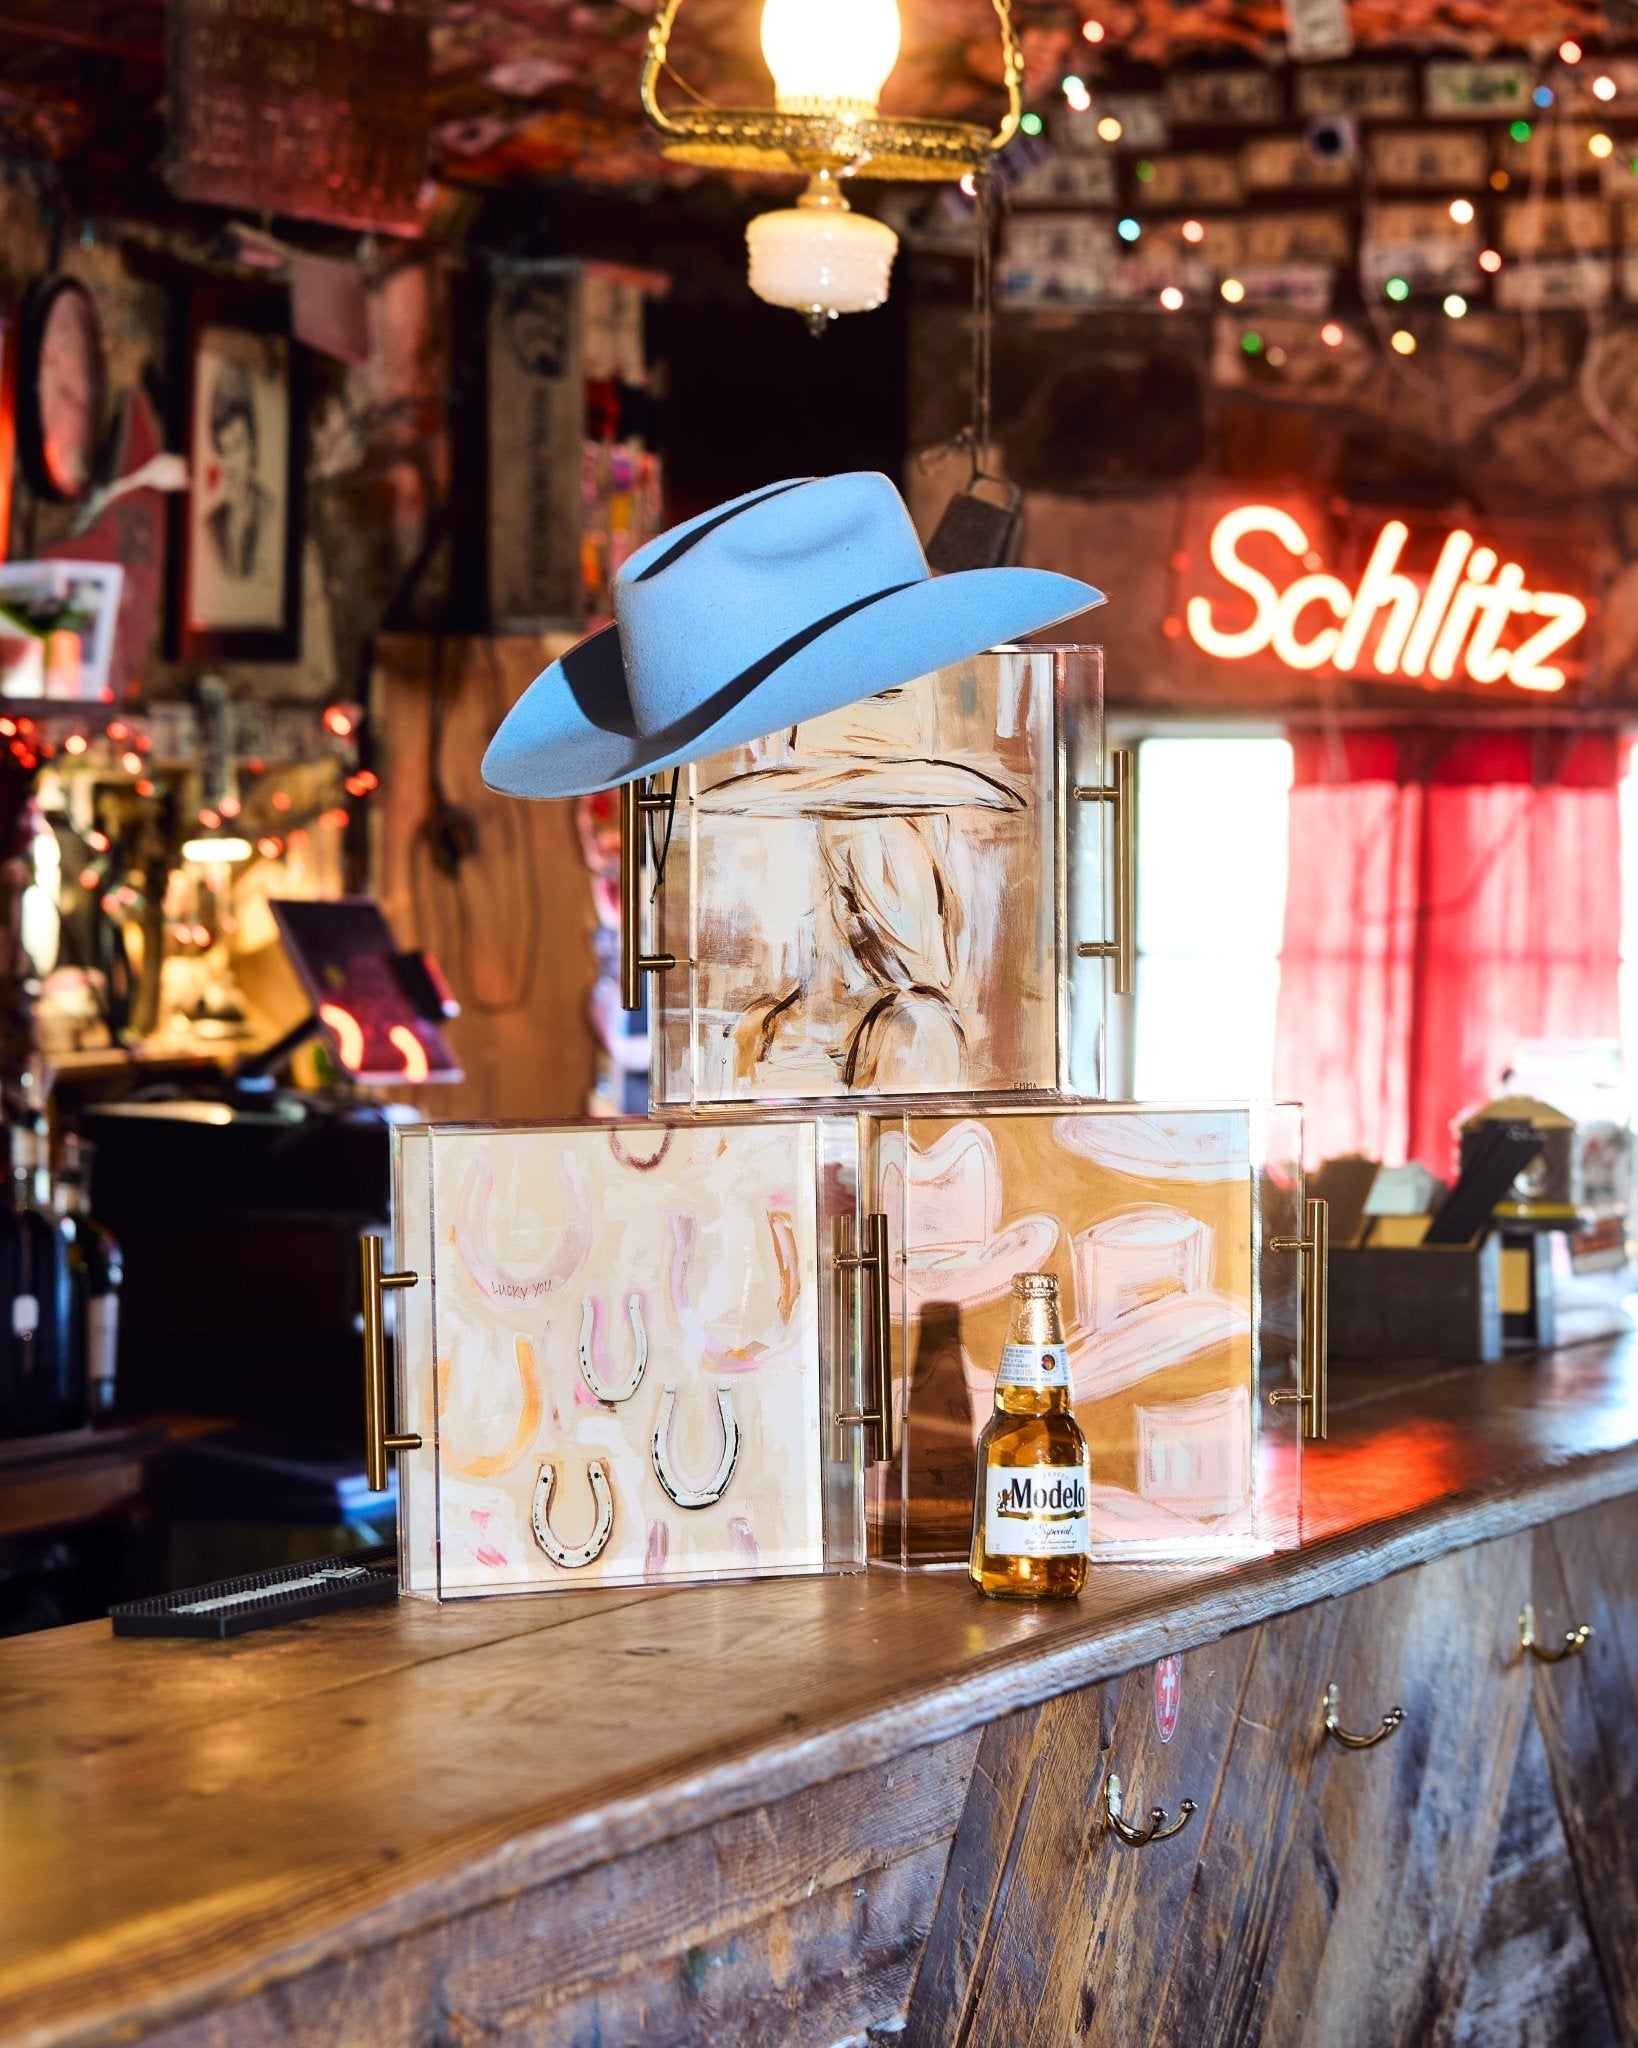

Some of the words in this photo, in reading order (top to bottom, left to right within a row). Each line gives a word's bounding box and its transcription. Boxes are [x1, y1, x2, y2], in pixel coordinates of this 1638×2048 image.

[1187, 505, 1586, 691] Schlitz
[1013, 1082, 1037, 1090] EMMA
[491, 1281, 528, 1301] LUCKY
[532, 1280, 553, 1298] YOU
[1011, 1478, 1085, 1508] Modelo
